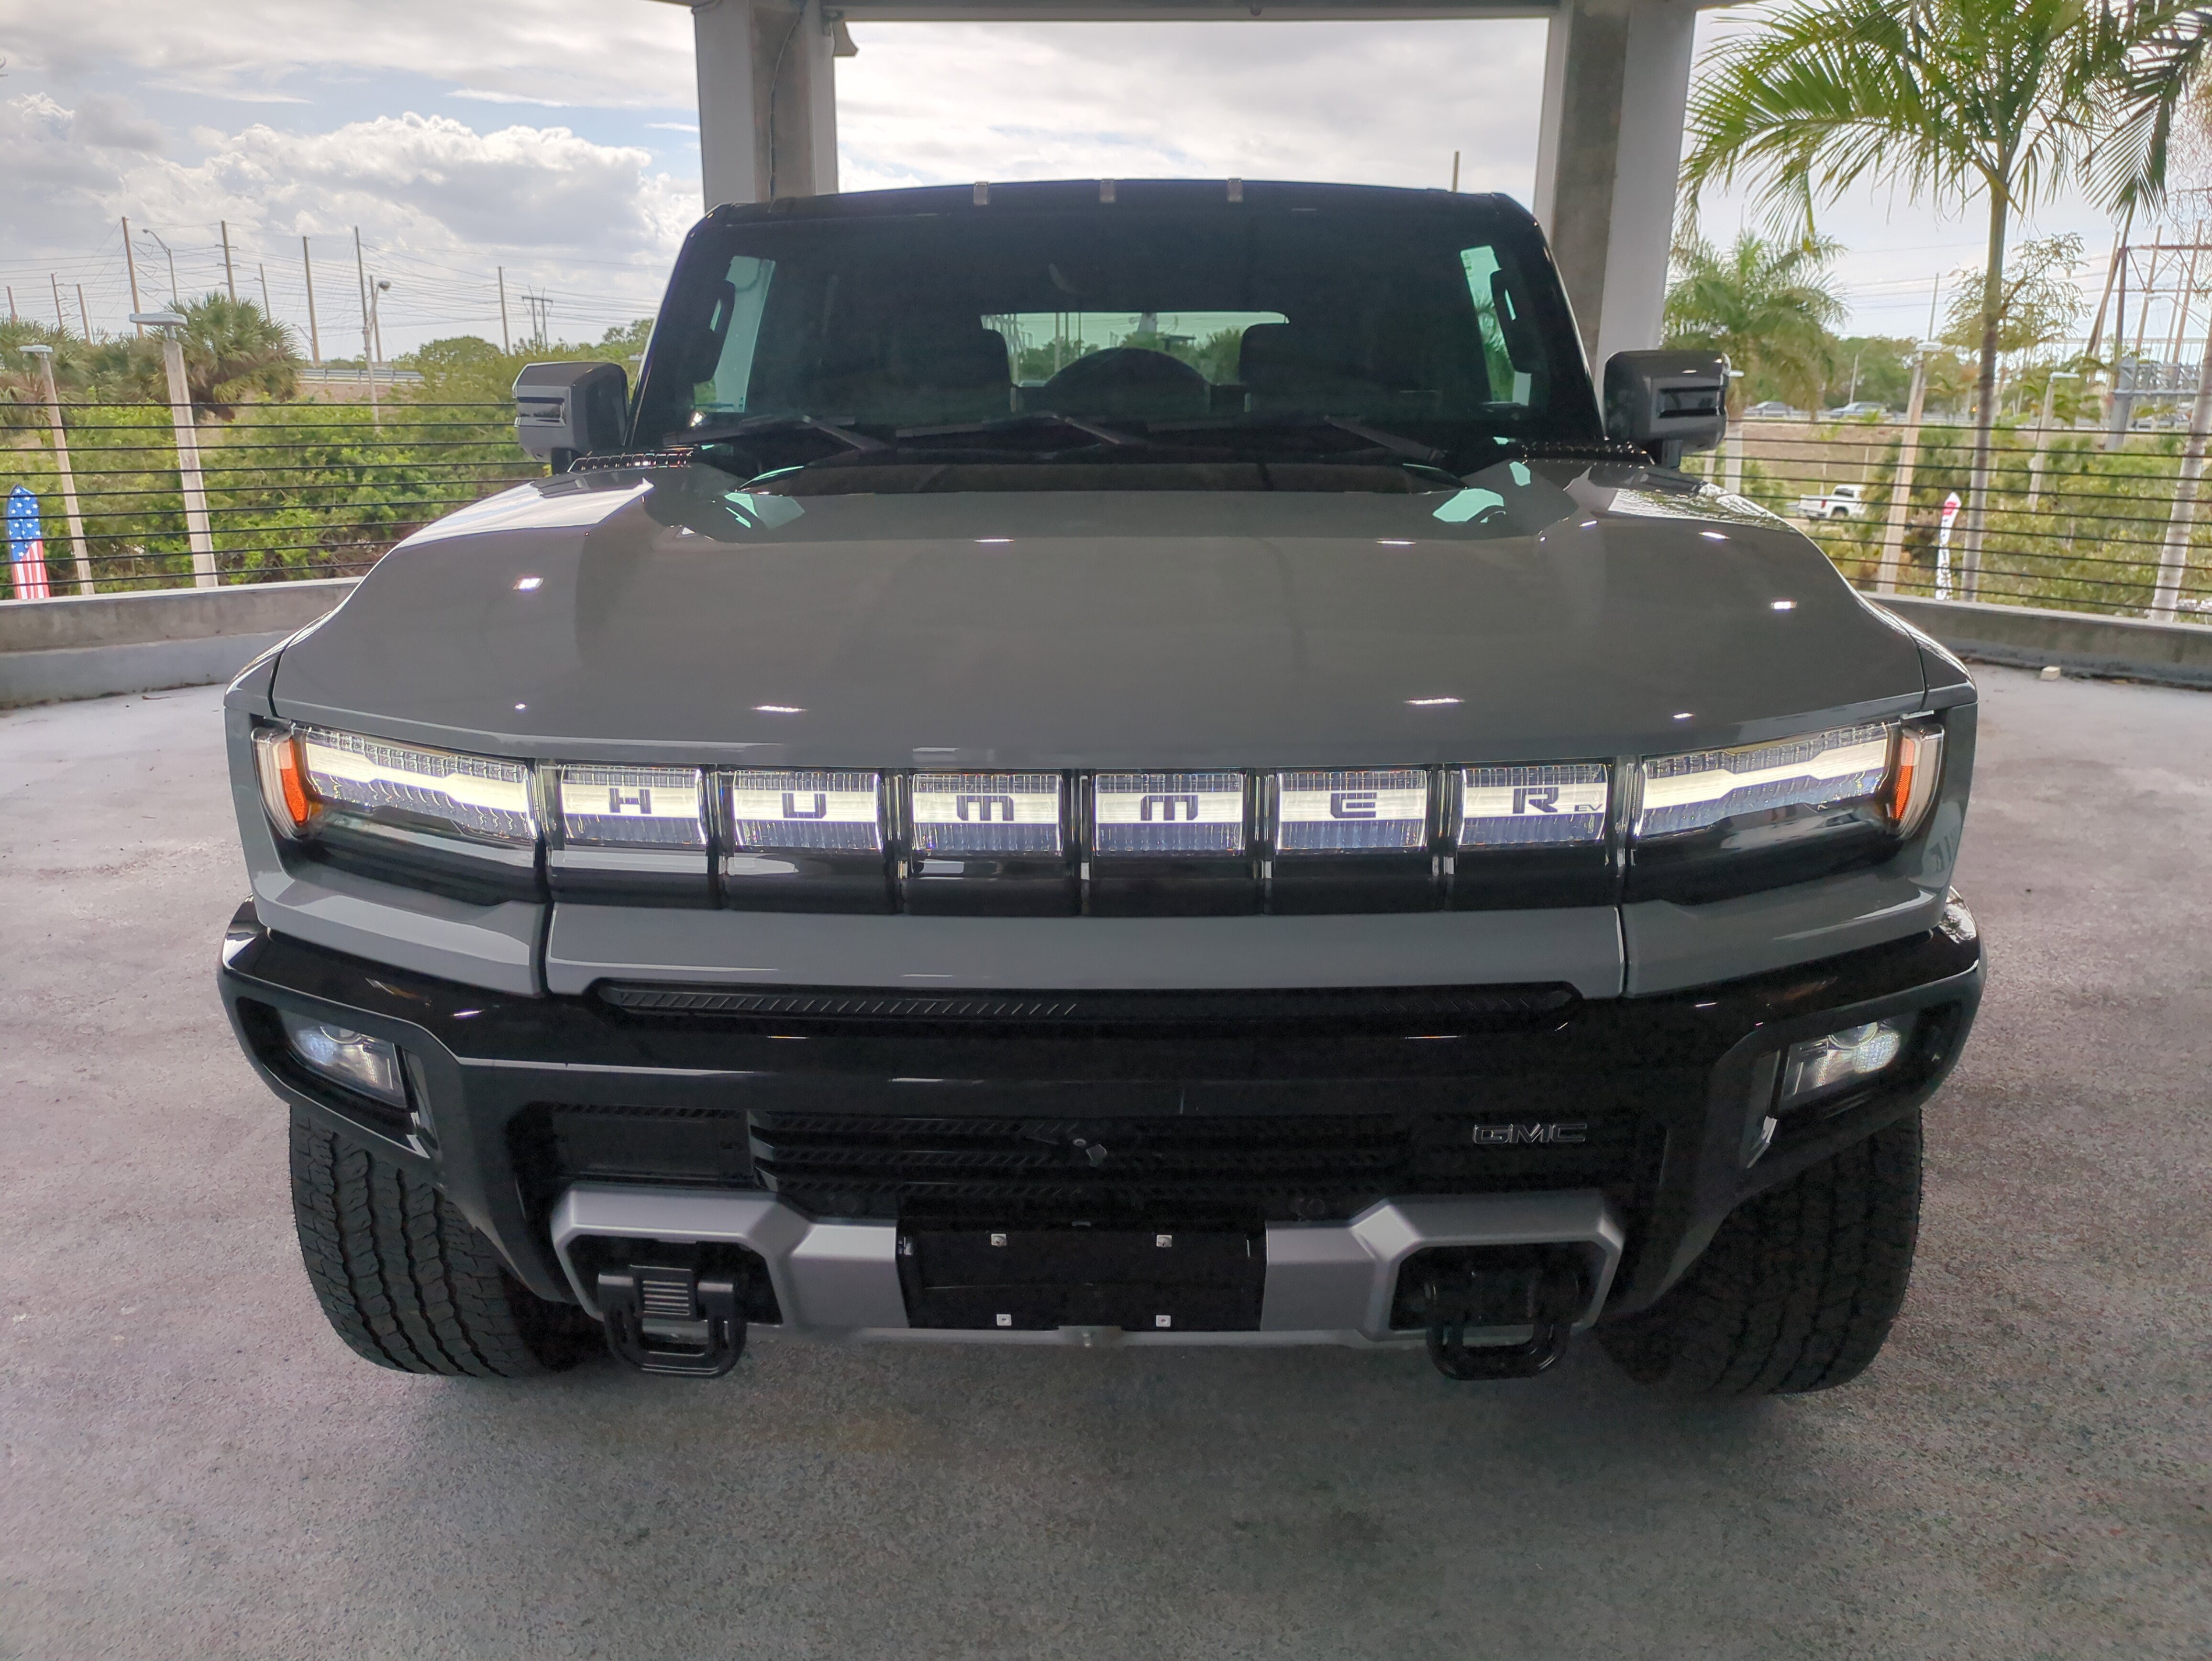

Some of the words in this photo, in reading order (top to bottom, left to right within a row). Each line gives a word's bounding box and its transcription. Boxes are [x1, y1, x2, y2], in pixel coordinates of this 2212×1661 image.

[609, 787, 1559, 821] HUMMER
[1574, 804, 1603, 812] EV
[1472, 1123, 1587, 1144] GMC
